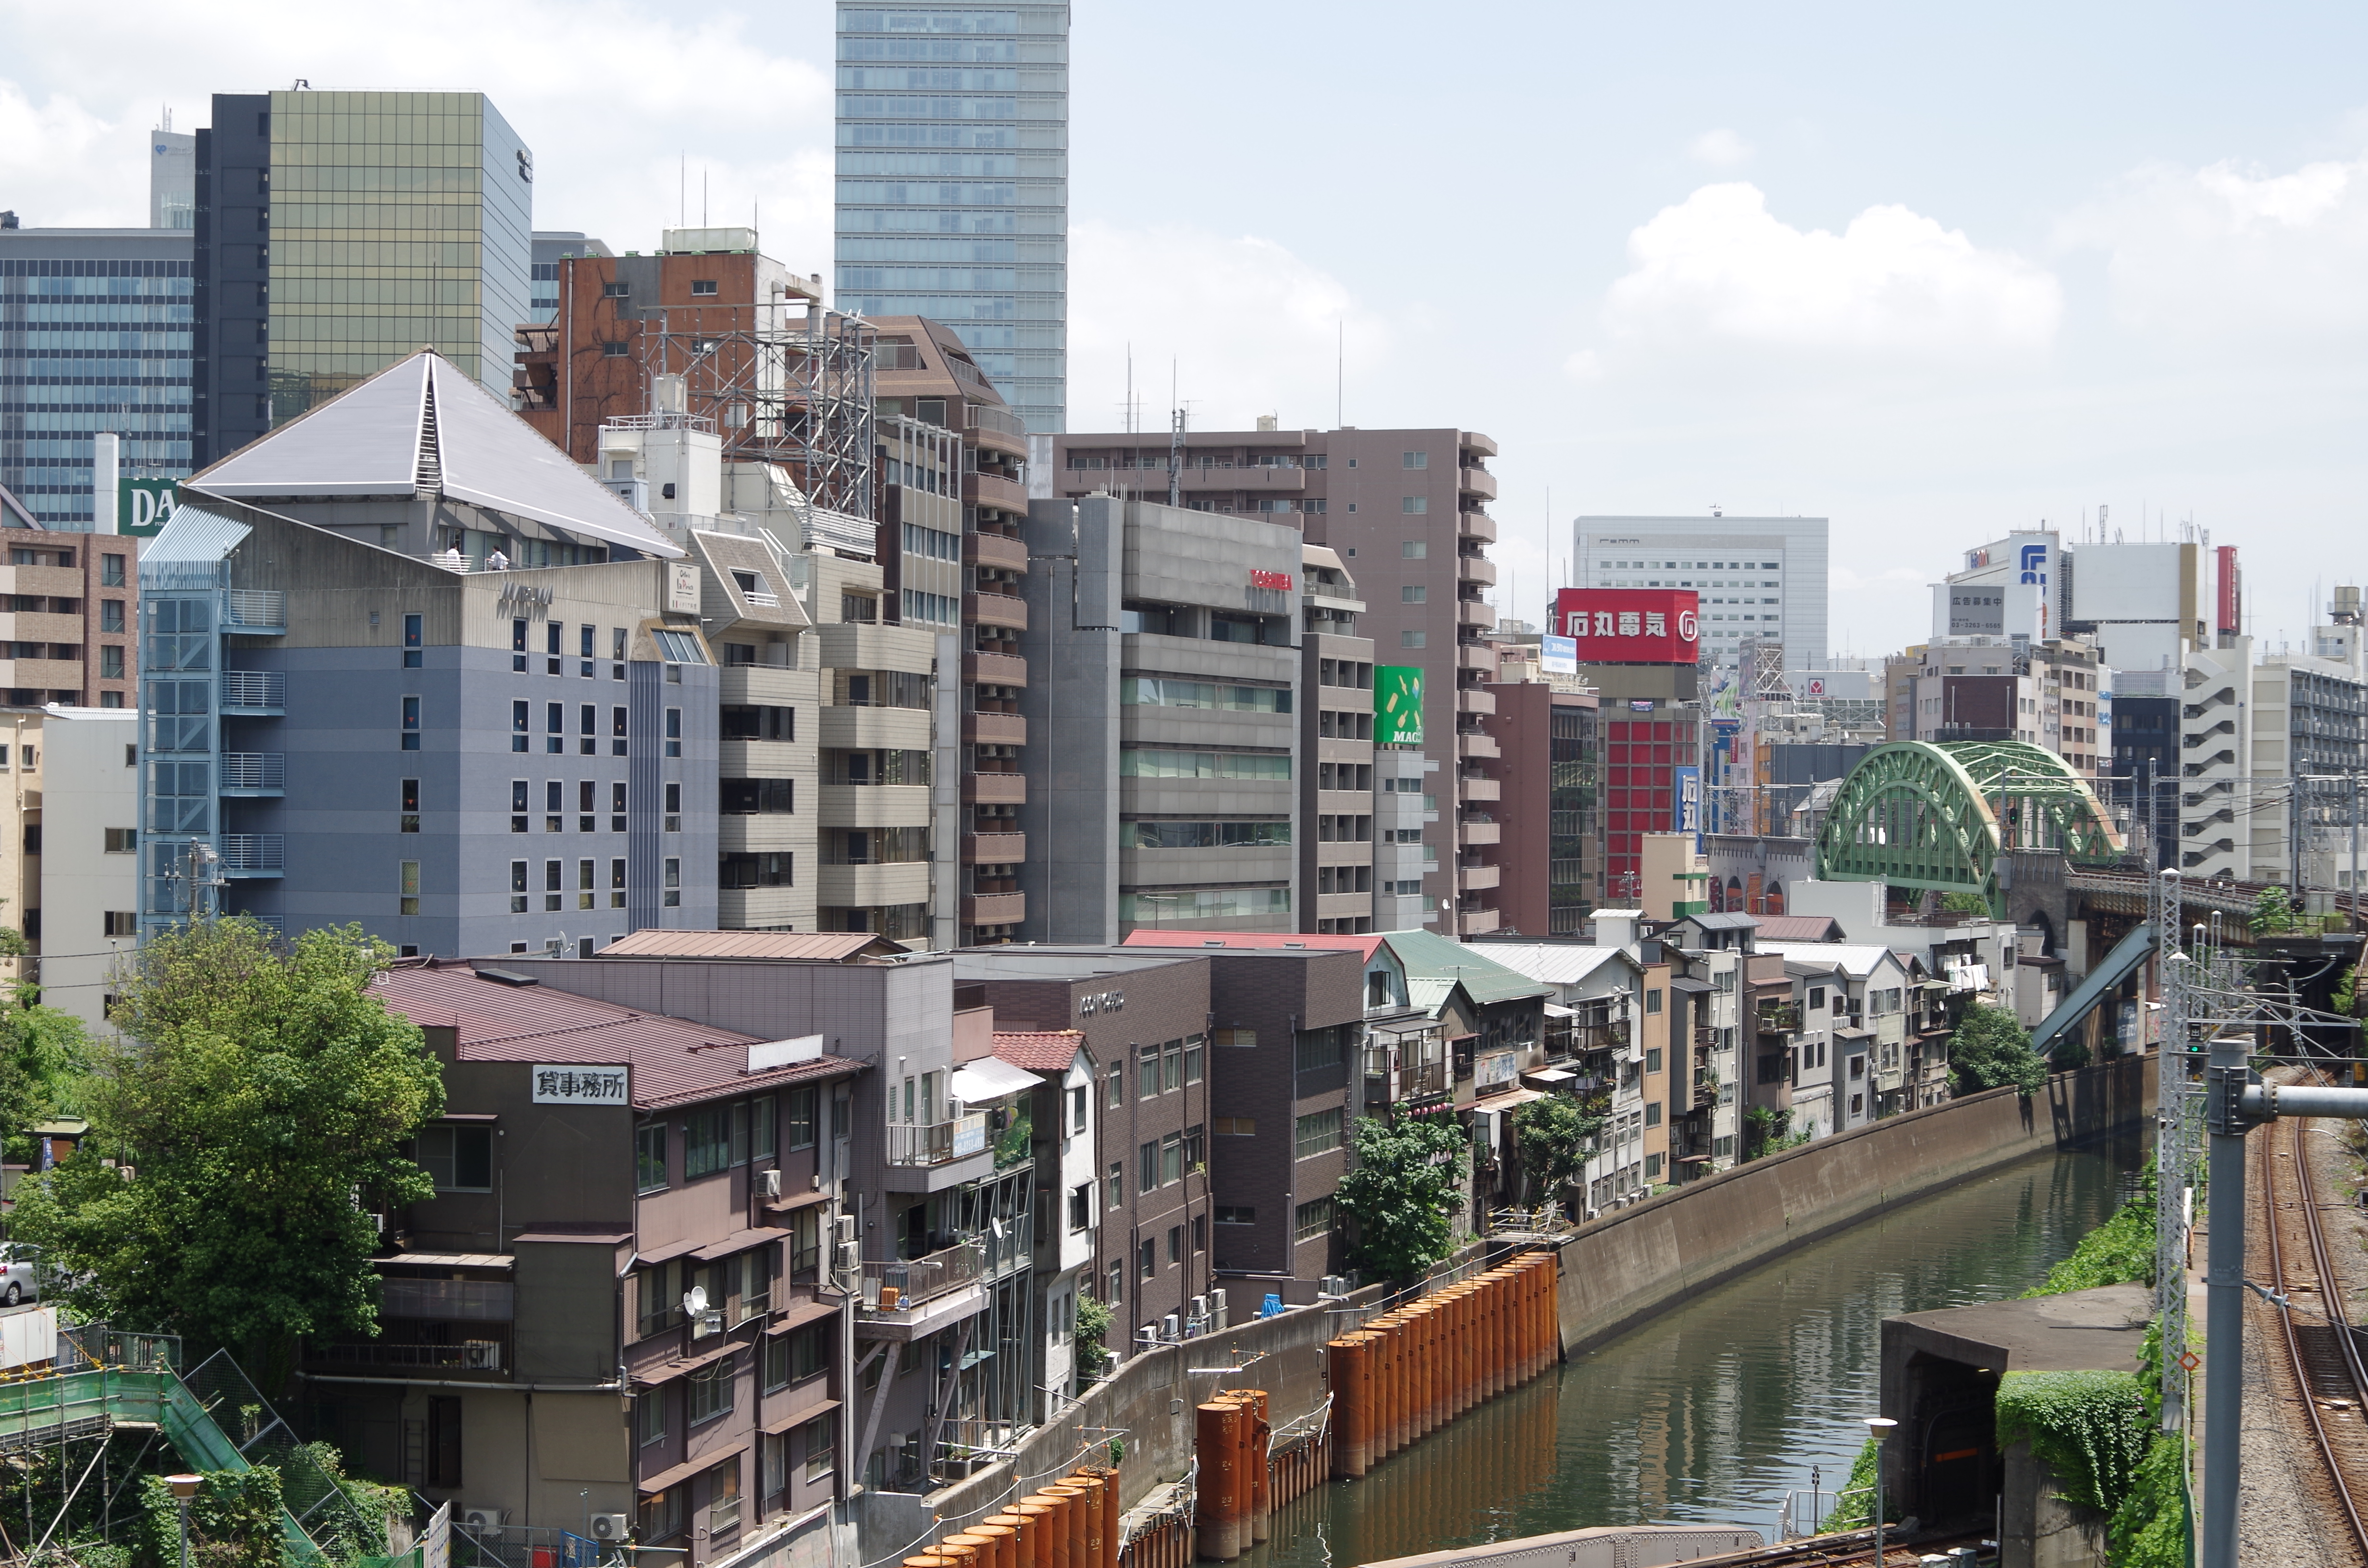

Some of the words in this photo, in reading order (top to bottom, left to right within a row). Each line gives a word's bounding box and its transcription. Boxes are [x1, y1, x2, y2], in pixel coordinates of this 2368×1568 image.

[1250, 569, 1293, 591] TOSHIBA
[1952, 597, 2002, 606] 広告募集中
[1566, 611, 1667, 637] 石丸電気
[537, 1070, 625, 1098] 貸事務所
